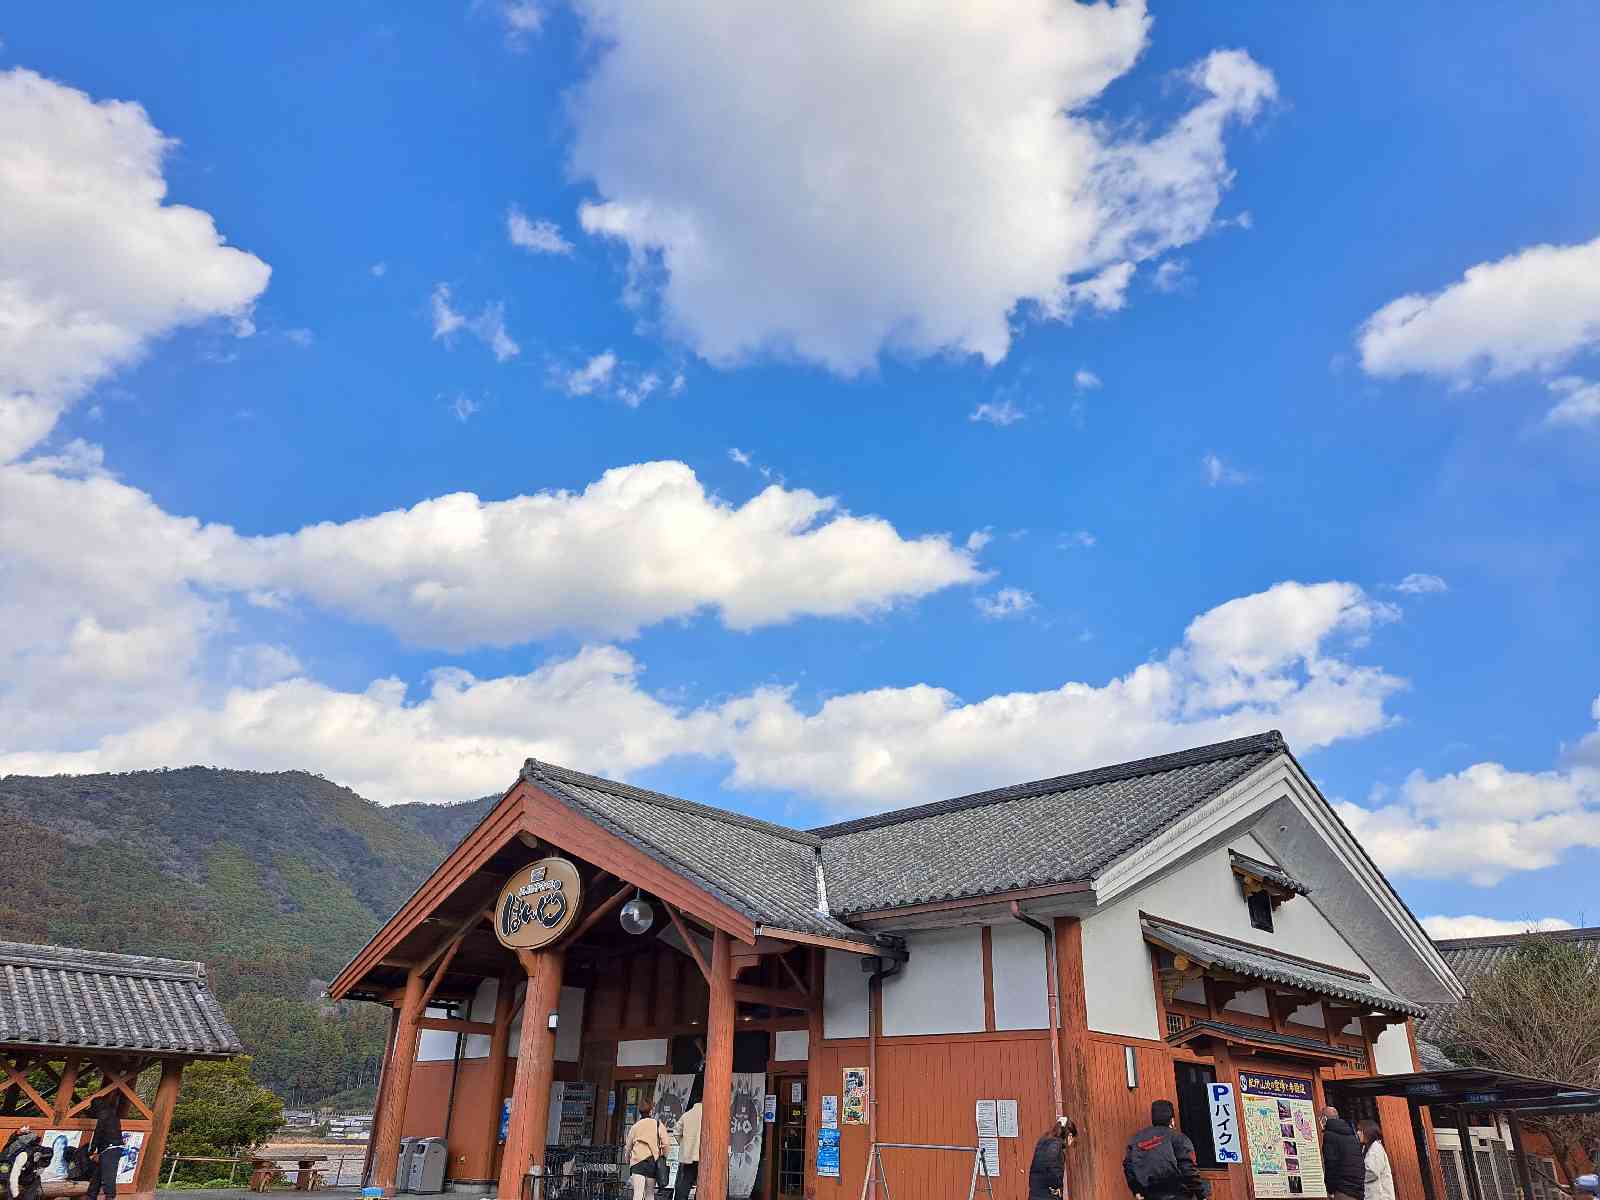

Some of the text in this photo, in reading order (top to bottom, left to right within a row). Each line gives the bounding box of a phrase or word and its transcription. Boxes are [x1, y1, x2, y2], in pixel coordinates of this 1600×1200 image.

[1212, 1085, 1232, 1146] P バイク
